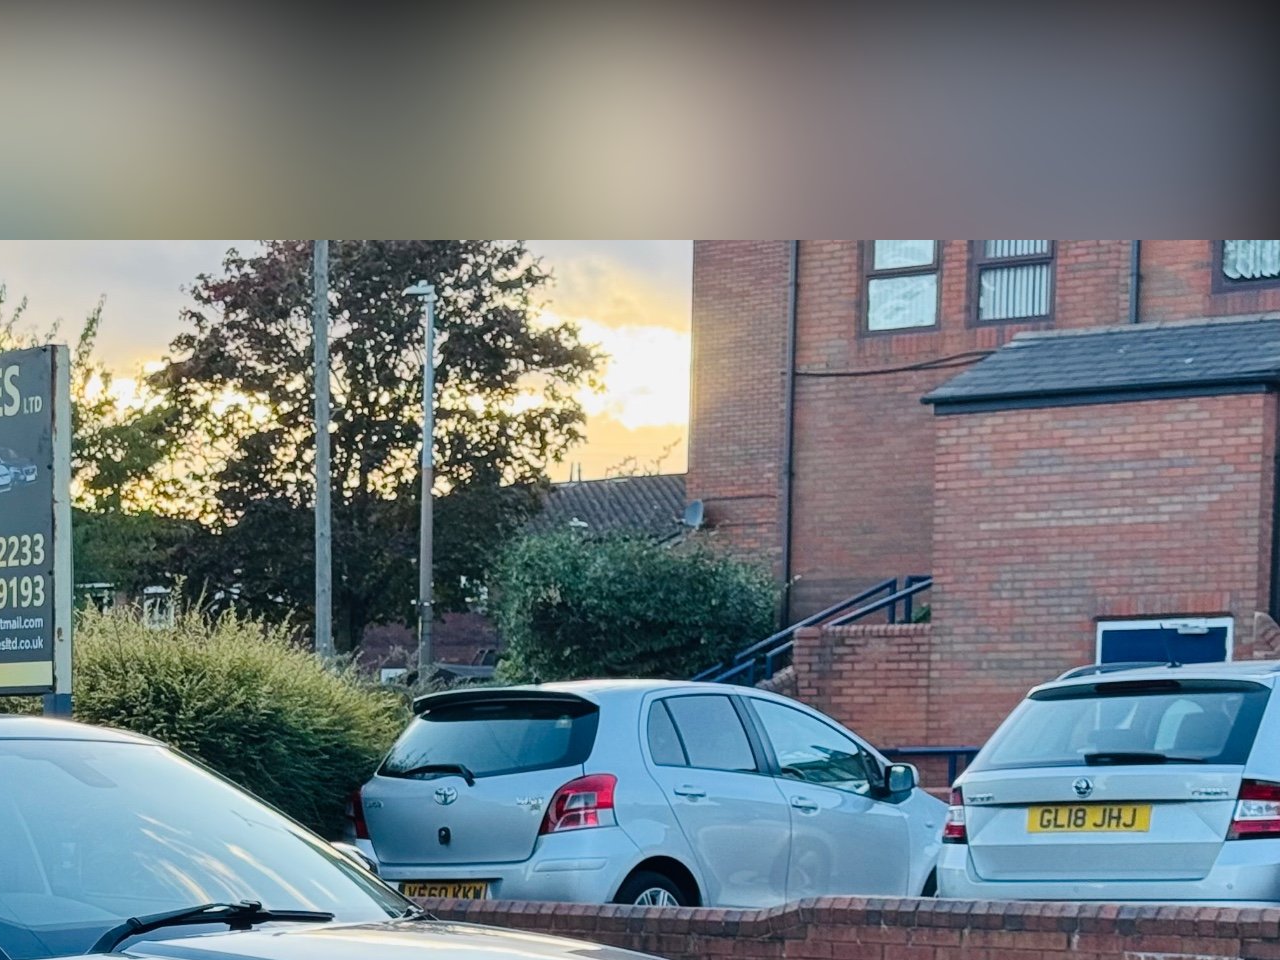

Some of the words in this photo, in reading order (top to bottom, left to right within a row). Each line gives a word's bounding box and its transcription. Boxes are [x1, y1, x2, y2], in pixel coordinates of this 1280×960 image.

[23, 395, 43, 415] LTD
[1039, 808, 1087, 828] GL18
[1093, 807, 1137, 828] JHJ
